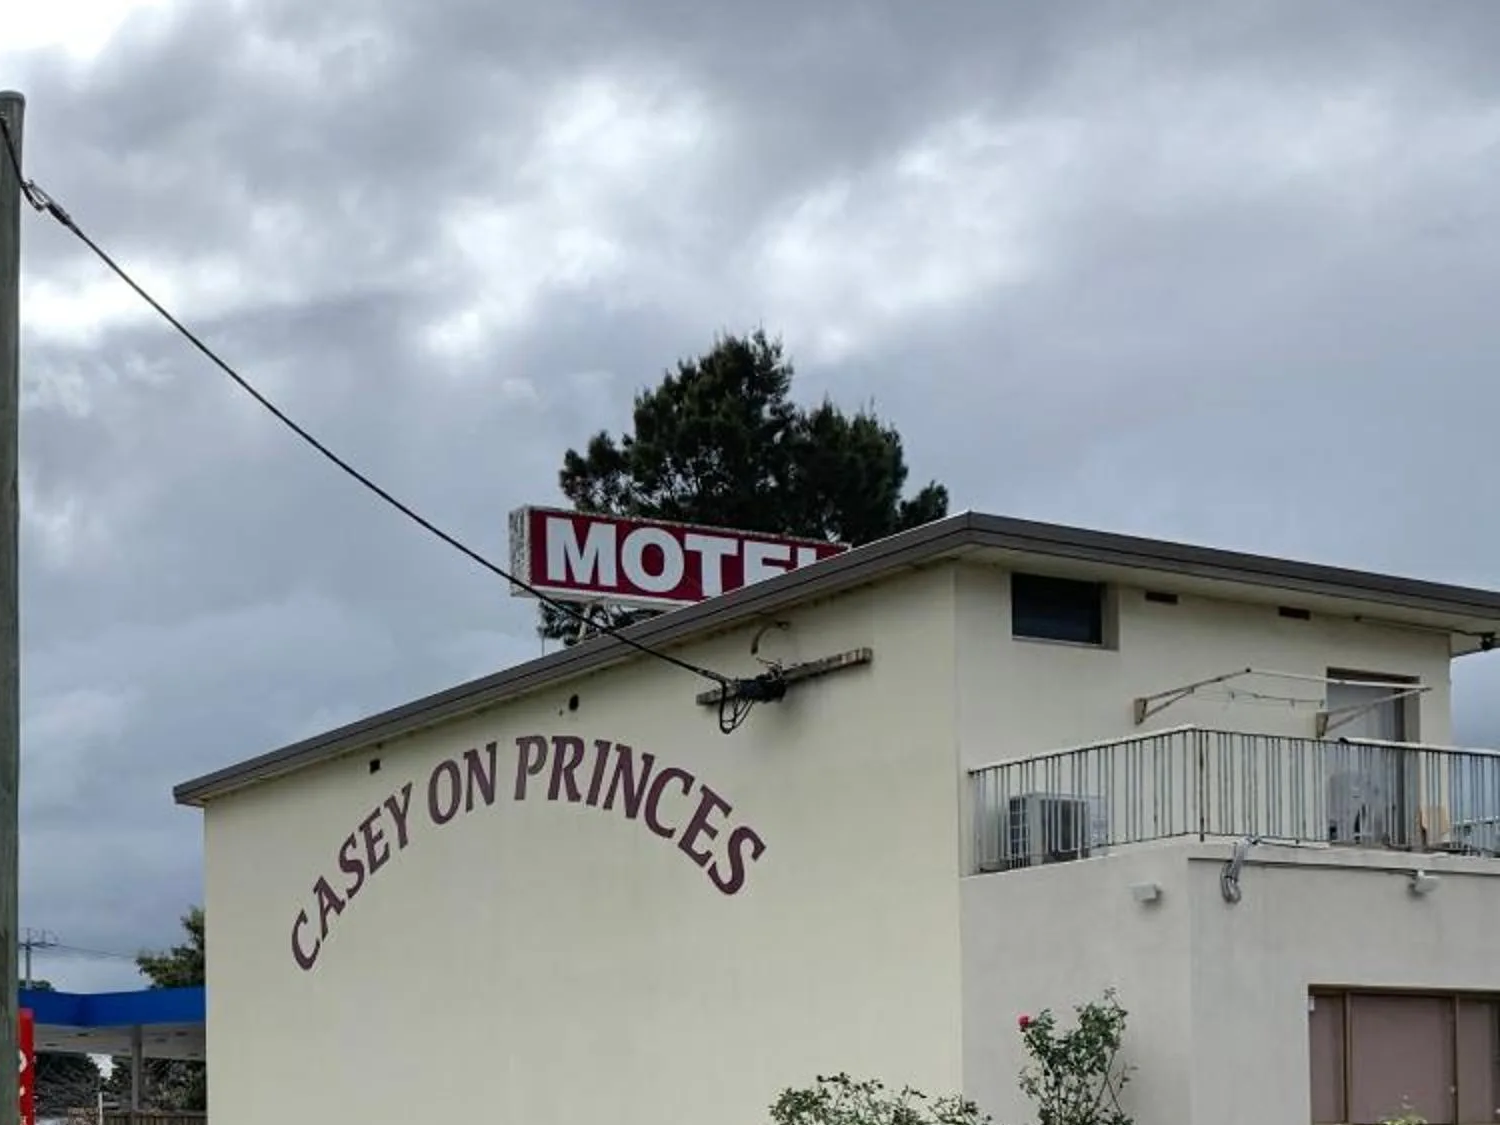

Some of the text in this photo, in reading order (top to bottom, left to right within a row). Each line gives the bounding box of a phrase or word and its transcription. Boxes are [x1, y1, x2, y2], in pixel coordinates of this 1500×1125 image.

[545, 516, 816, 598] MOTE
[291, 735, 766, 970] CASEY ON PRINCES
